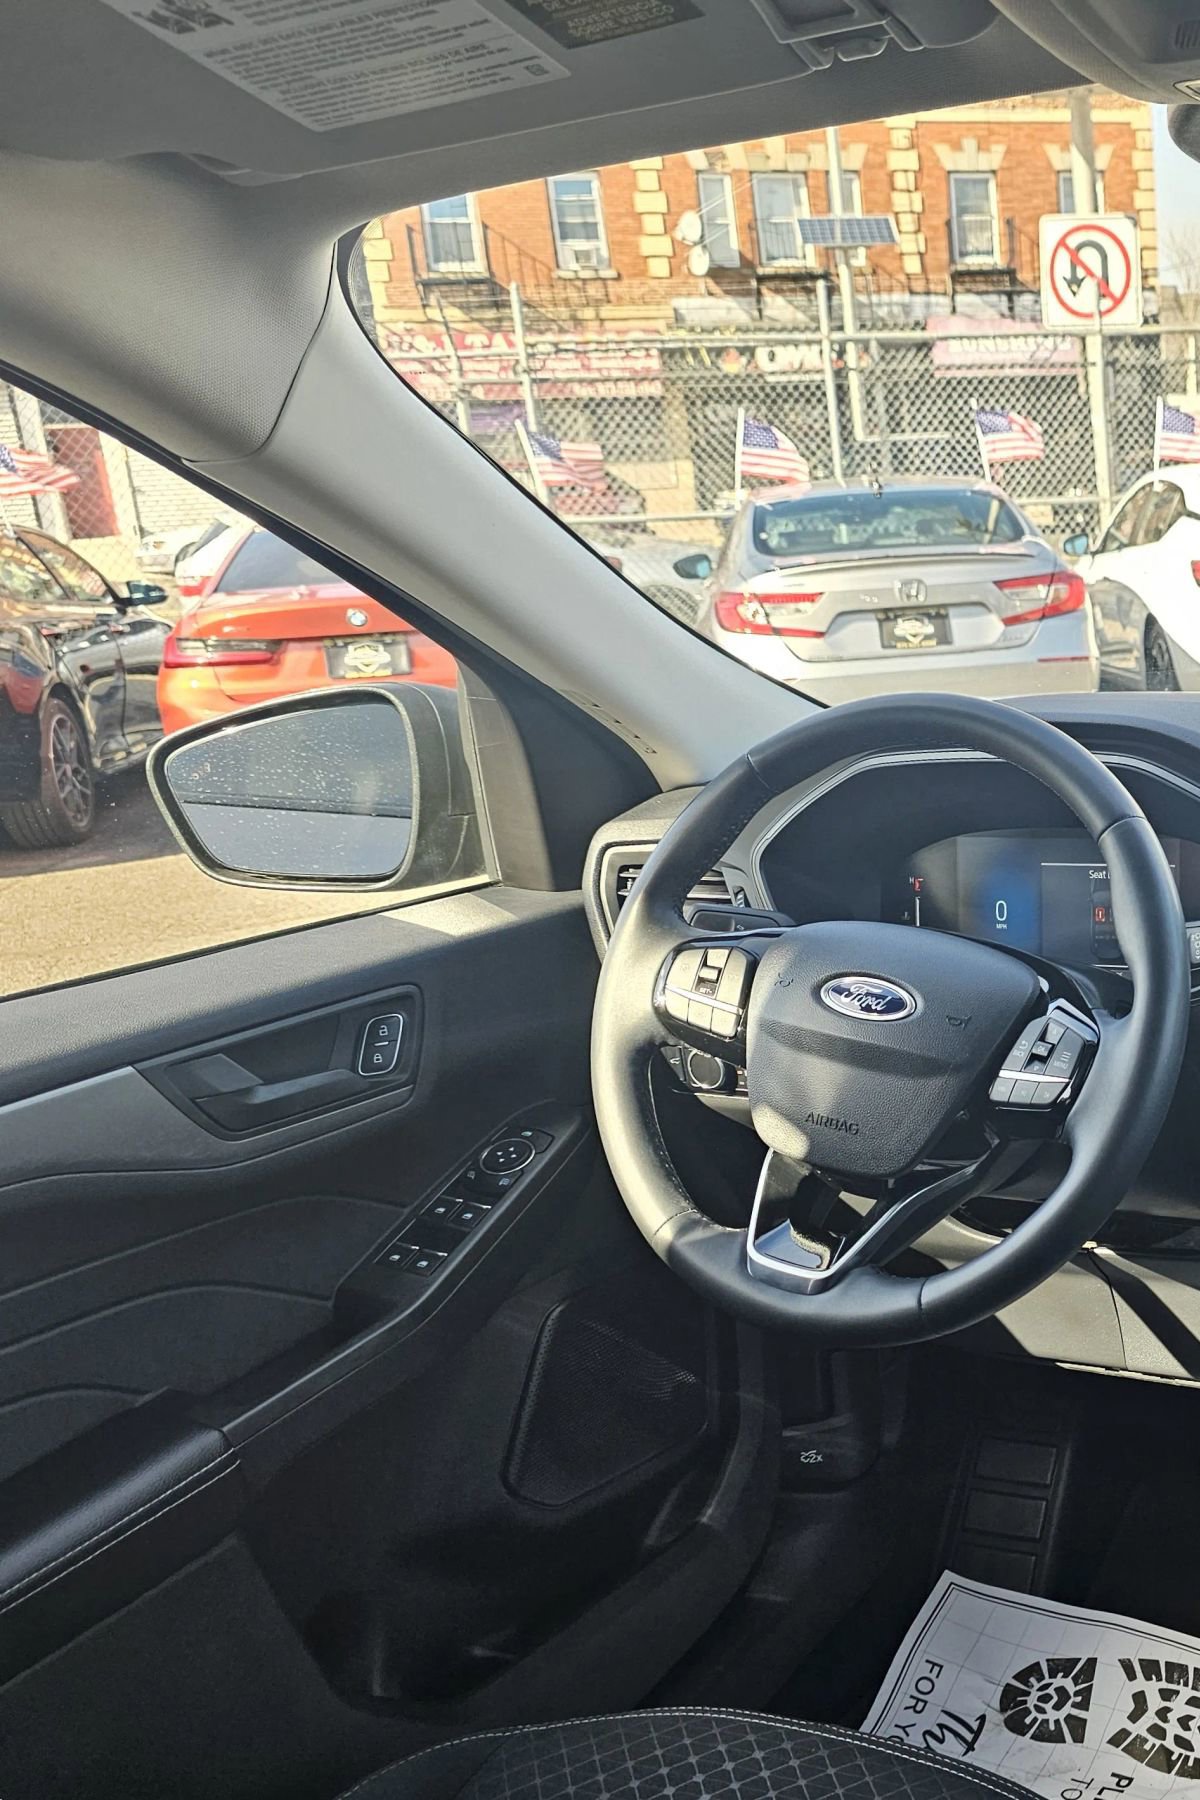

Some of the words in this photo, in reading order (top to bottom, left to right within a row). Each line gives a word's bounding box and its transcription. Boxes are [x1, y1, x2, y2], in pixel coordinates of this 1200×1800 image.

[1088, 870, 1106, 879] Seat
[996, 900, 1008, 921] 0
[805, 1111, 860, 1136] AIRBAG
[904, 1659, 944, 1714] FOR
